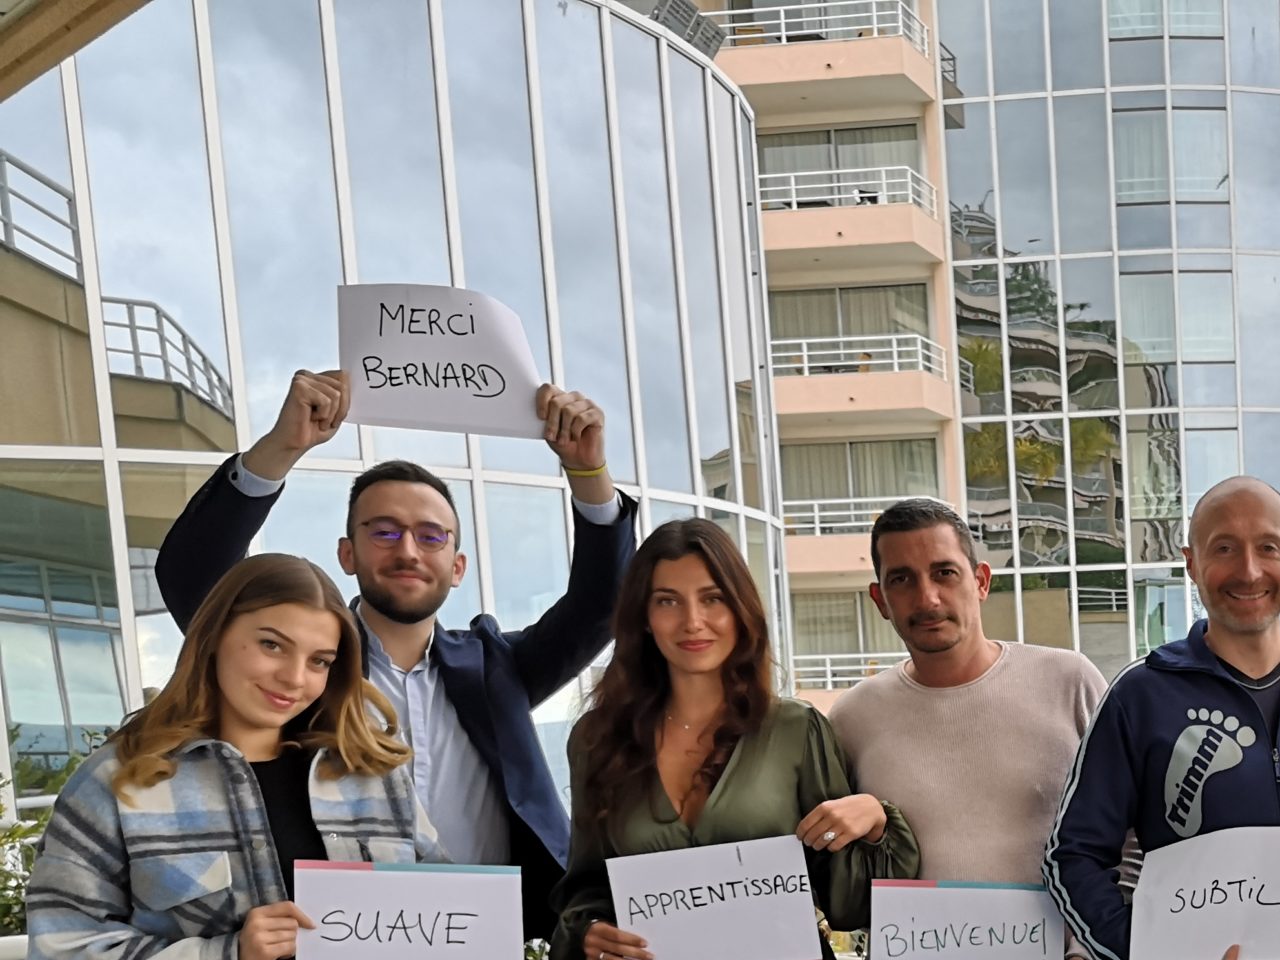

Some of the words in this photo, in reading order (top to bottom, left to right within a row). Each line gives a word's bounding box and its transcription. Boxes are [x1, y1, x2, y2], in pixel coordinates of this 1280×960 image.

[362, 355, 506, 397] BERNARD
[1167, 727, 1223, 828] Trimm
[320, 909, 479, 947] SUAVE
